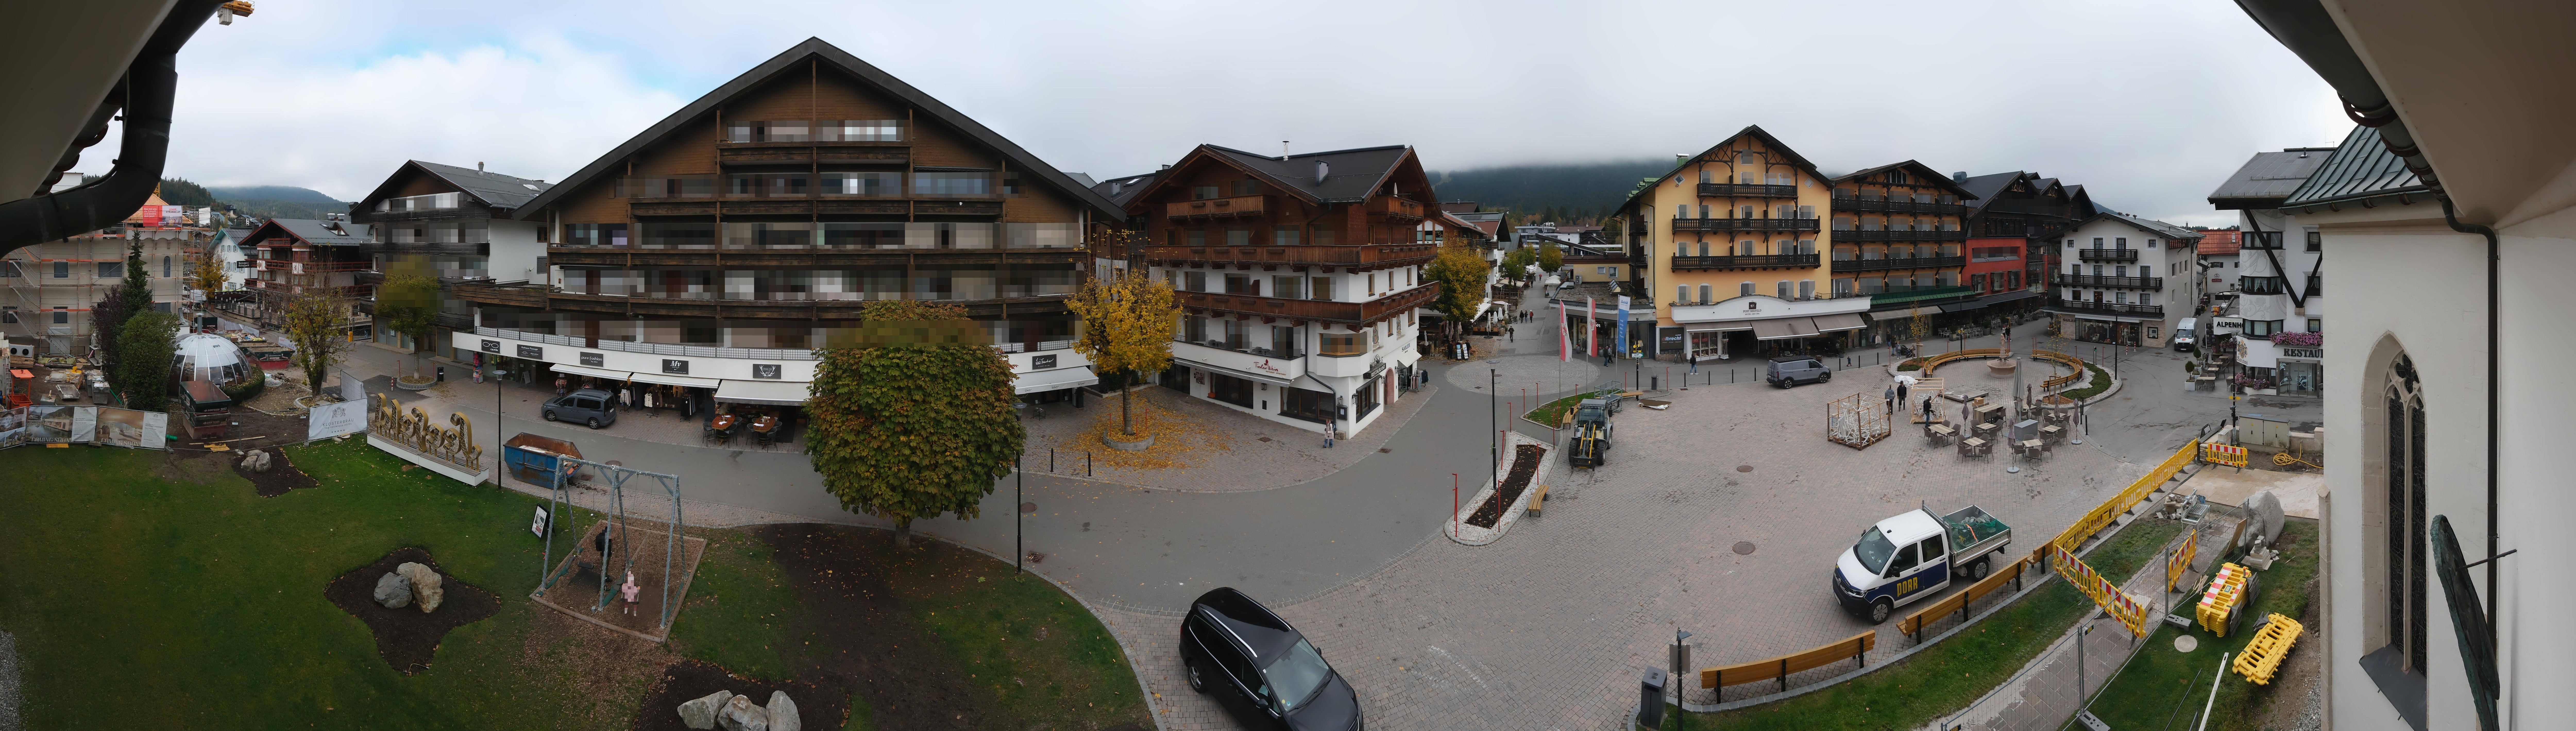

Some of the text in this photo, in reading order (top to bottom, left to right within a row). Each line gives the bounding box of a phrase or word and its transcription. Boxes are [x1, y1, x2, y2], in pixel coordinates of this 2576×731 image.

[1371, 364, 1385, 377] RESTAURANT
[323, 418, 354, 427] KLOSTERBRÄU
[1897, 577, 1918, 597] PORR
